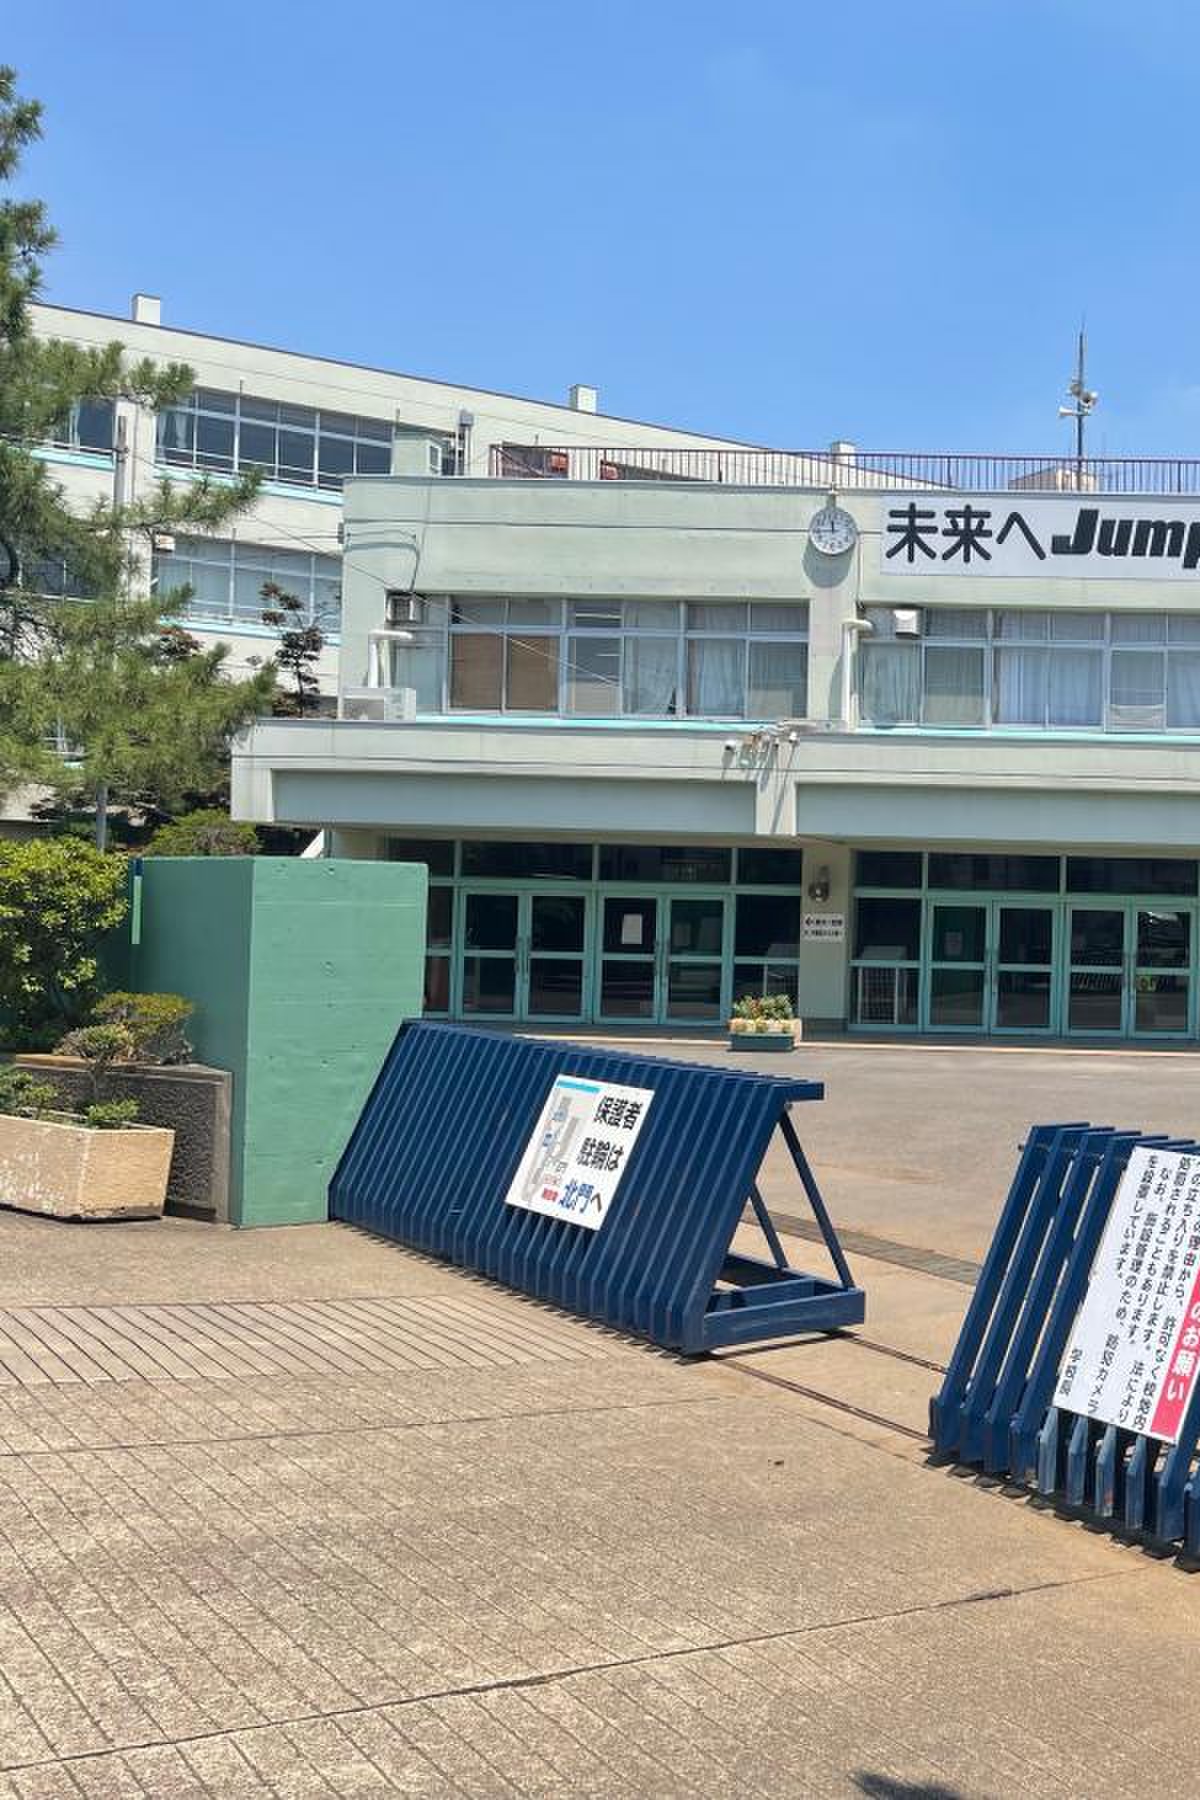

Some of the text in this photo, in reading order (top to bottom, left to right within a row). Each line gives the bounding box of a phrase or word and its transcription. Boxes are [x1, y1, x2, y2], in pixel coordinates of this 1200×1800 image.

[594, 1095, 643, 1130] 保護者
[576, 1137, 624, 1172] 駐輪は
